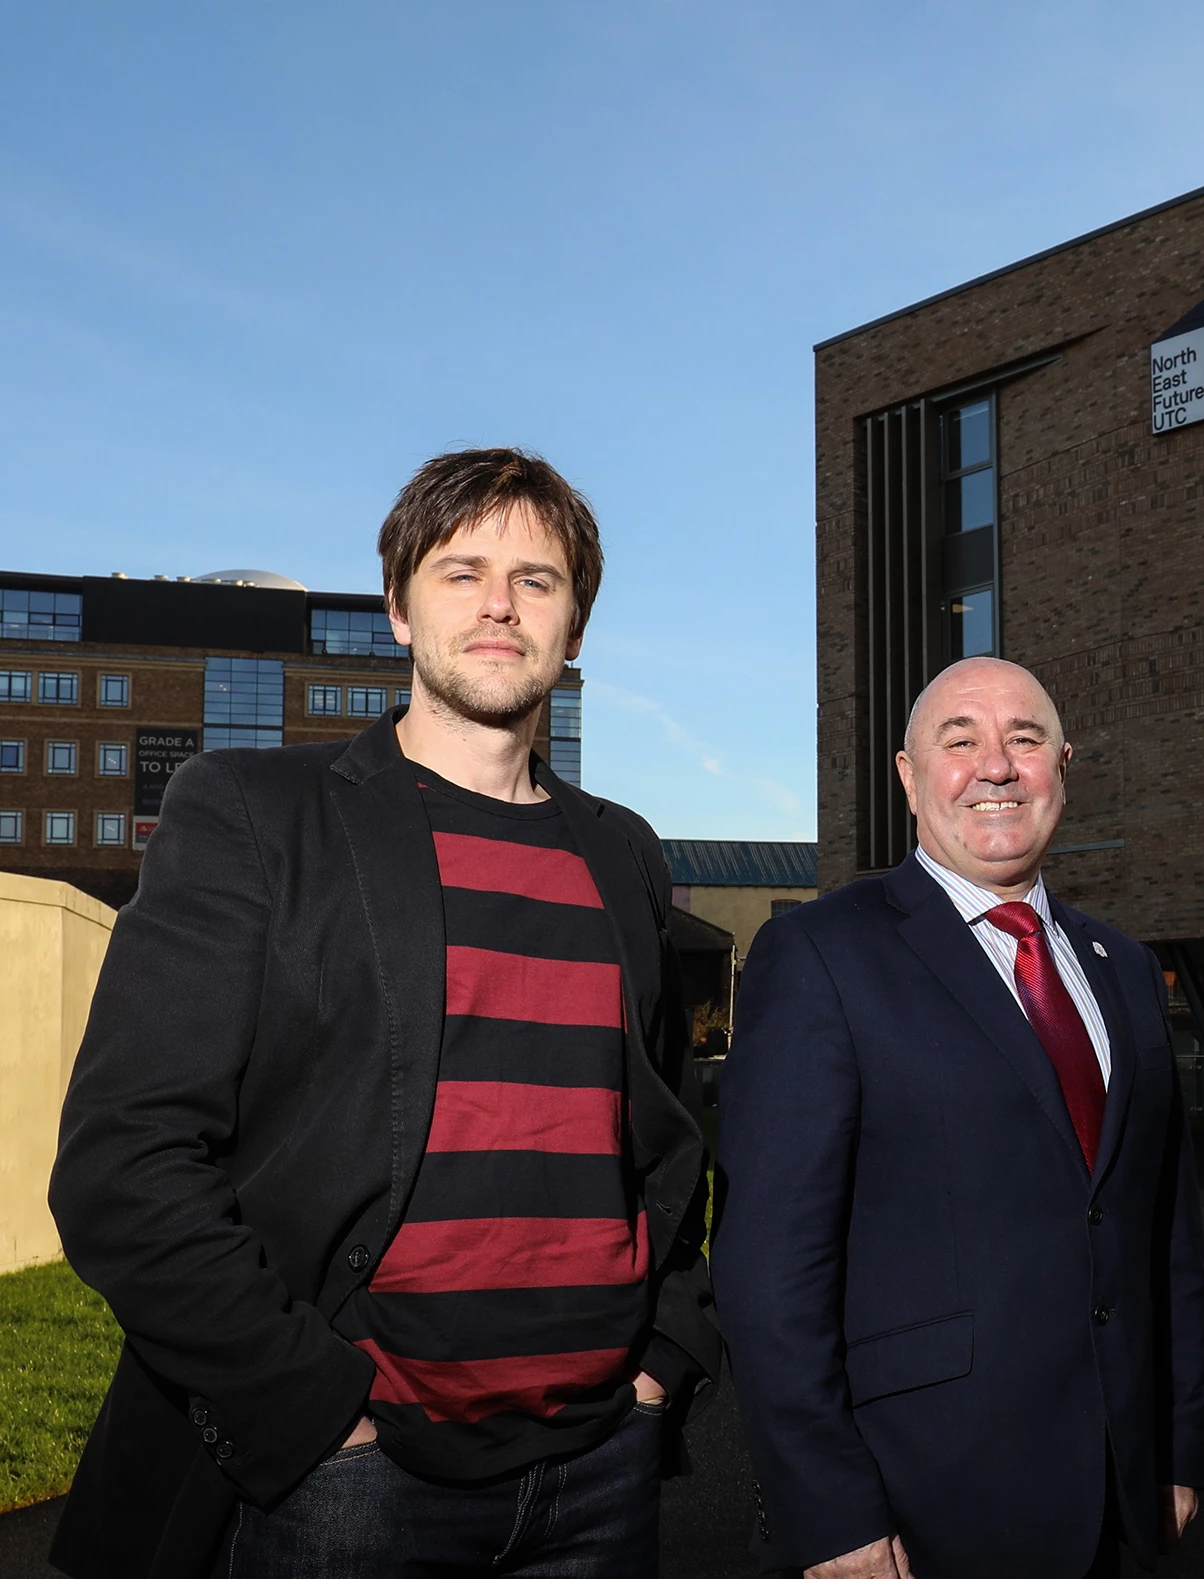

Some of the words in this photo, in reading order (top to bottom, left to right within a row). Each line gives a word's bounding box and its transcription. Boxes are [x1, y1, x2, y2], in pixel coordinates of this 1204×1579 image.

[1153, 347, 1197, 375] North
[1153, 369, 1187, 394] East
[1153, 407, 1187, 431] UTC
[139, 736, 182, 747] GRADE
[185, 738, 195, 747] A
[138, 750, 168, 758] OFFICE
[140, 761, 161, 773] TO
